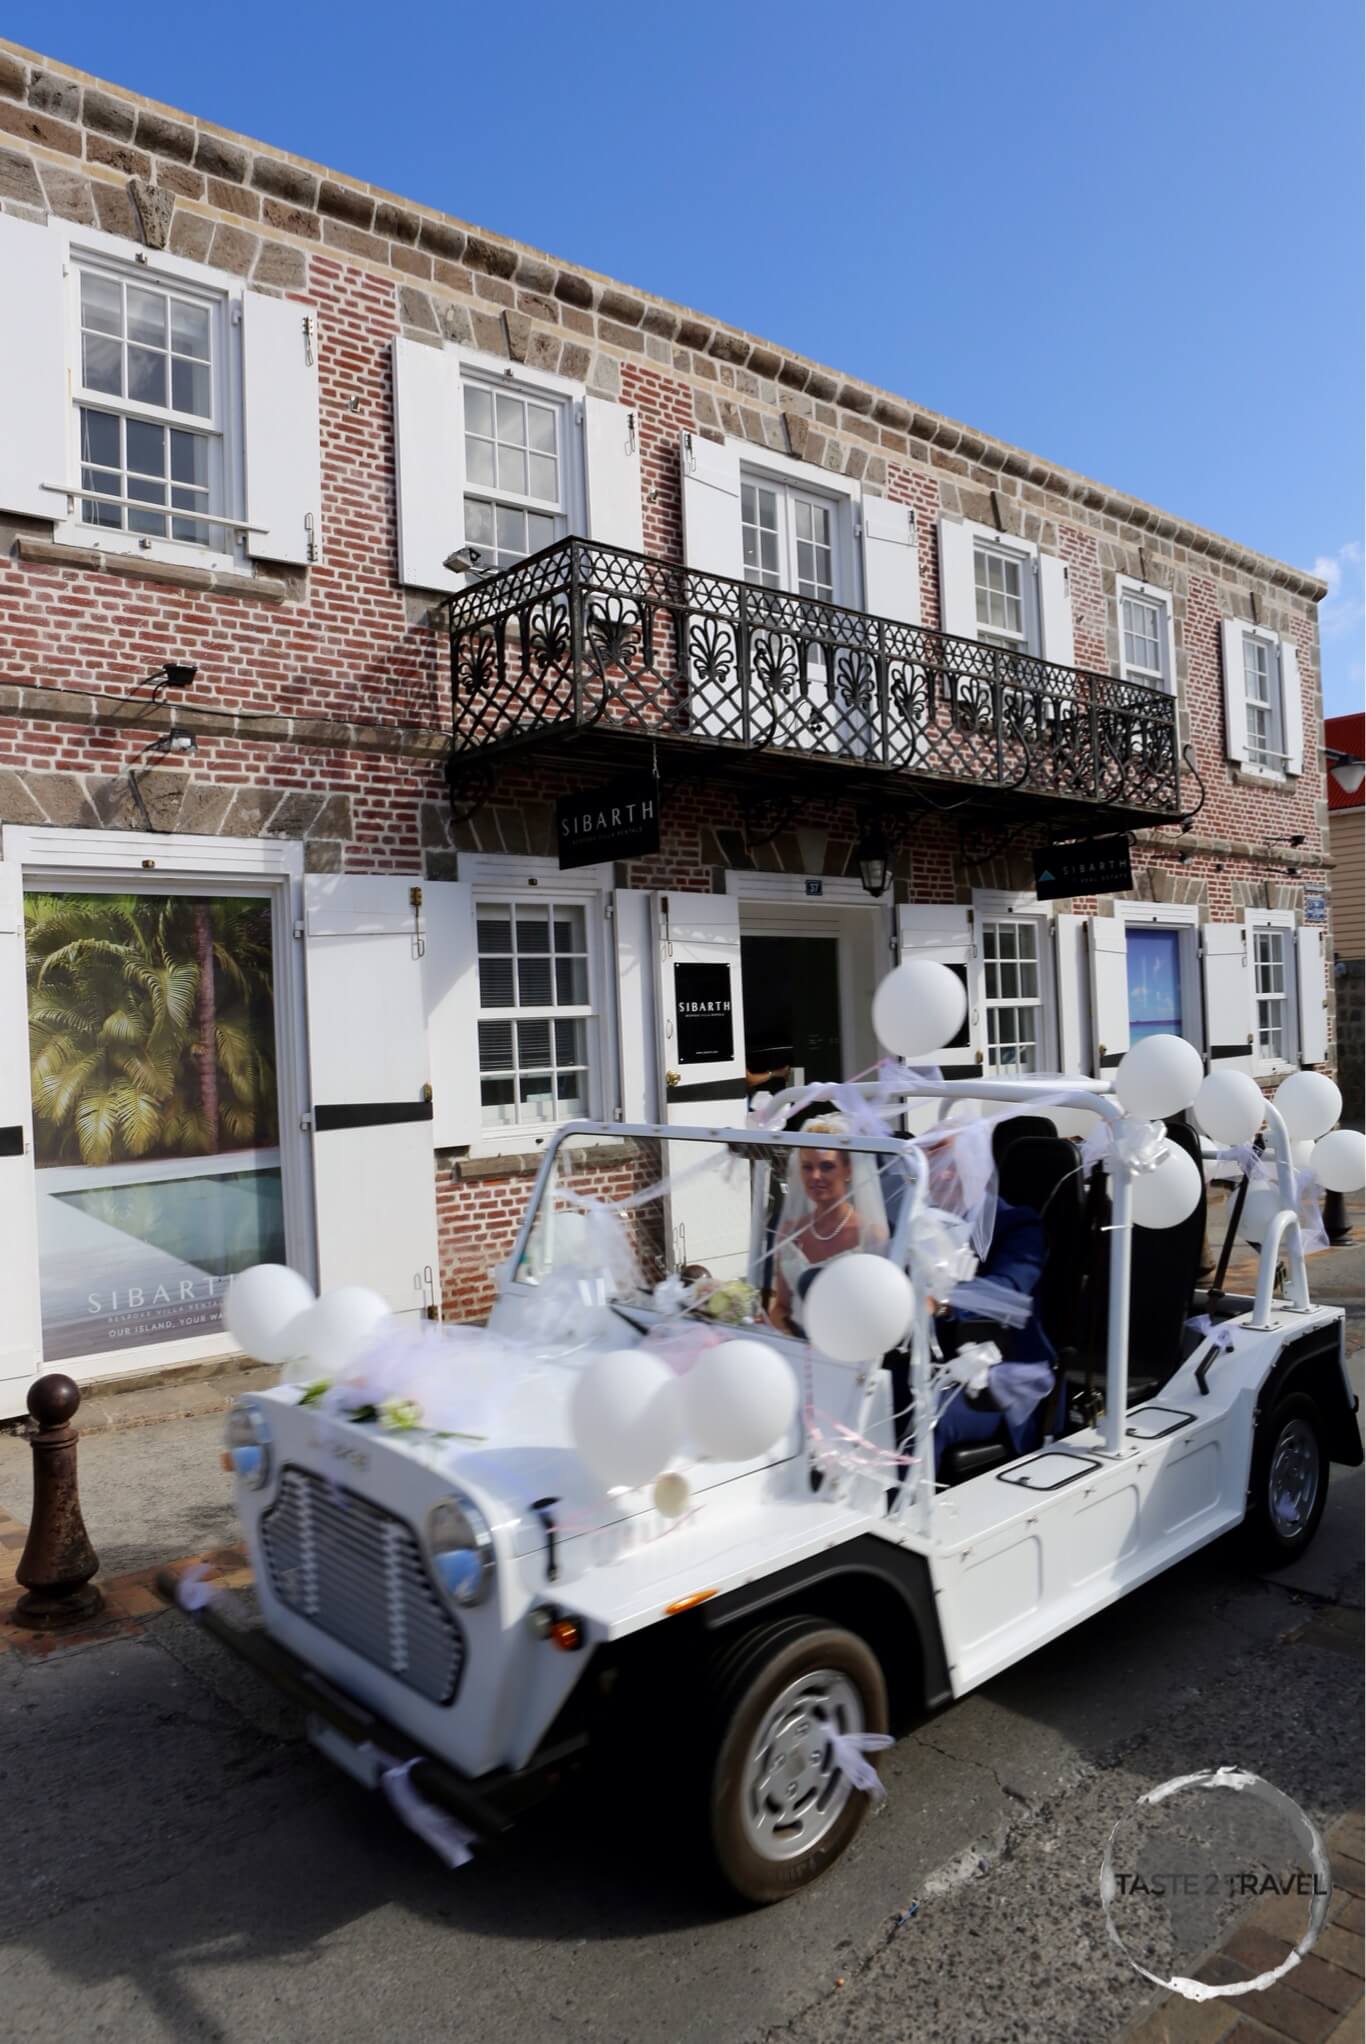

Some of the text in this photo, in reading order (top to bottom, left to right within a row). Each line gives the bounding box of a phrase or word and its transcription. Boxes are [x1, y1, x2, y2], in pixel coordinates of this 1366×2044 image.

[561, 800, 654, 837] SIBARTH
[1061, 859, 1127, 876] SIBARTH
[678, 1001, 731, 1012] SIBARTH
[108, 1312, 223, 1338] OUR ISLAND, YOUR WA
